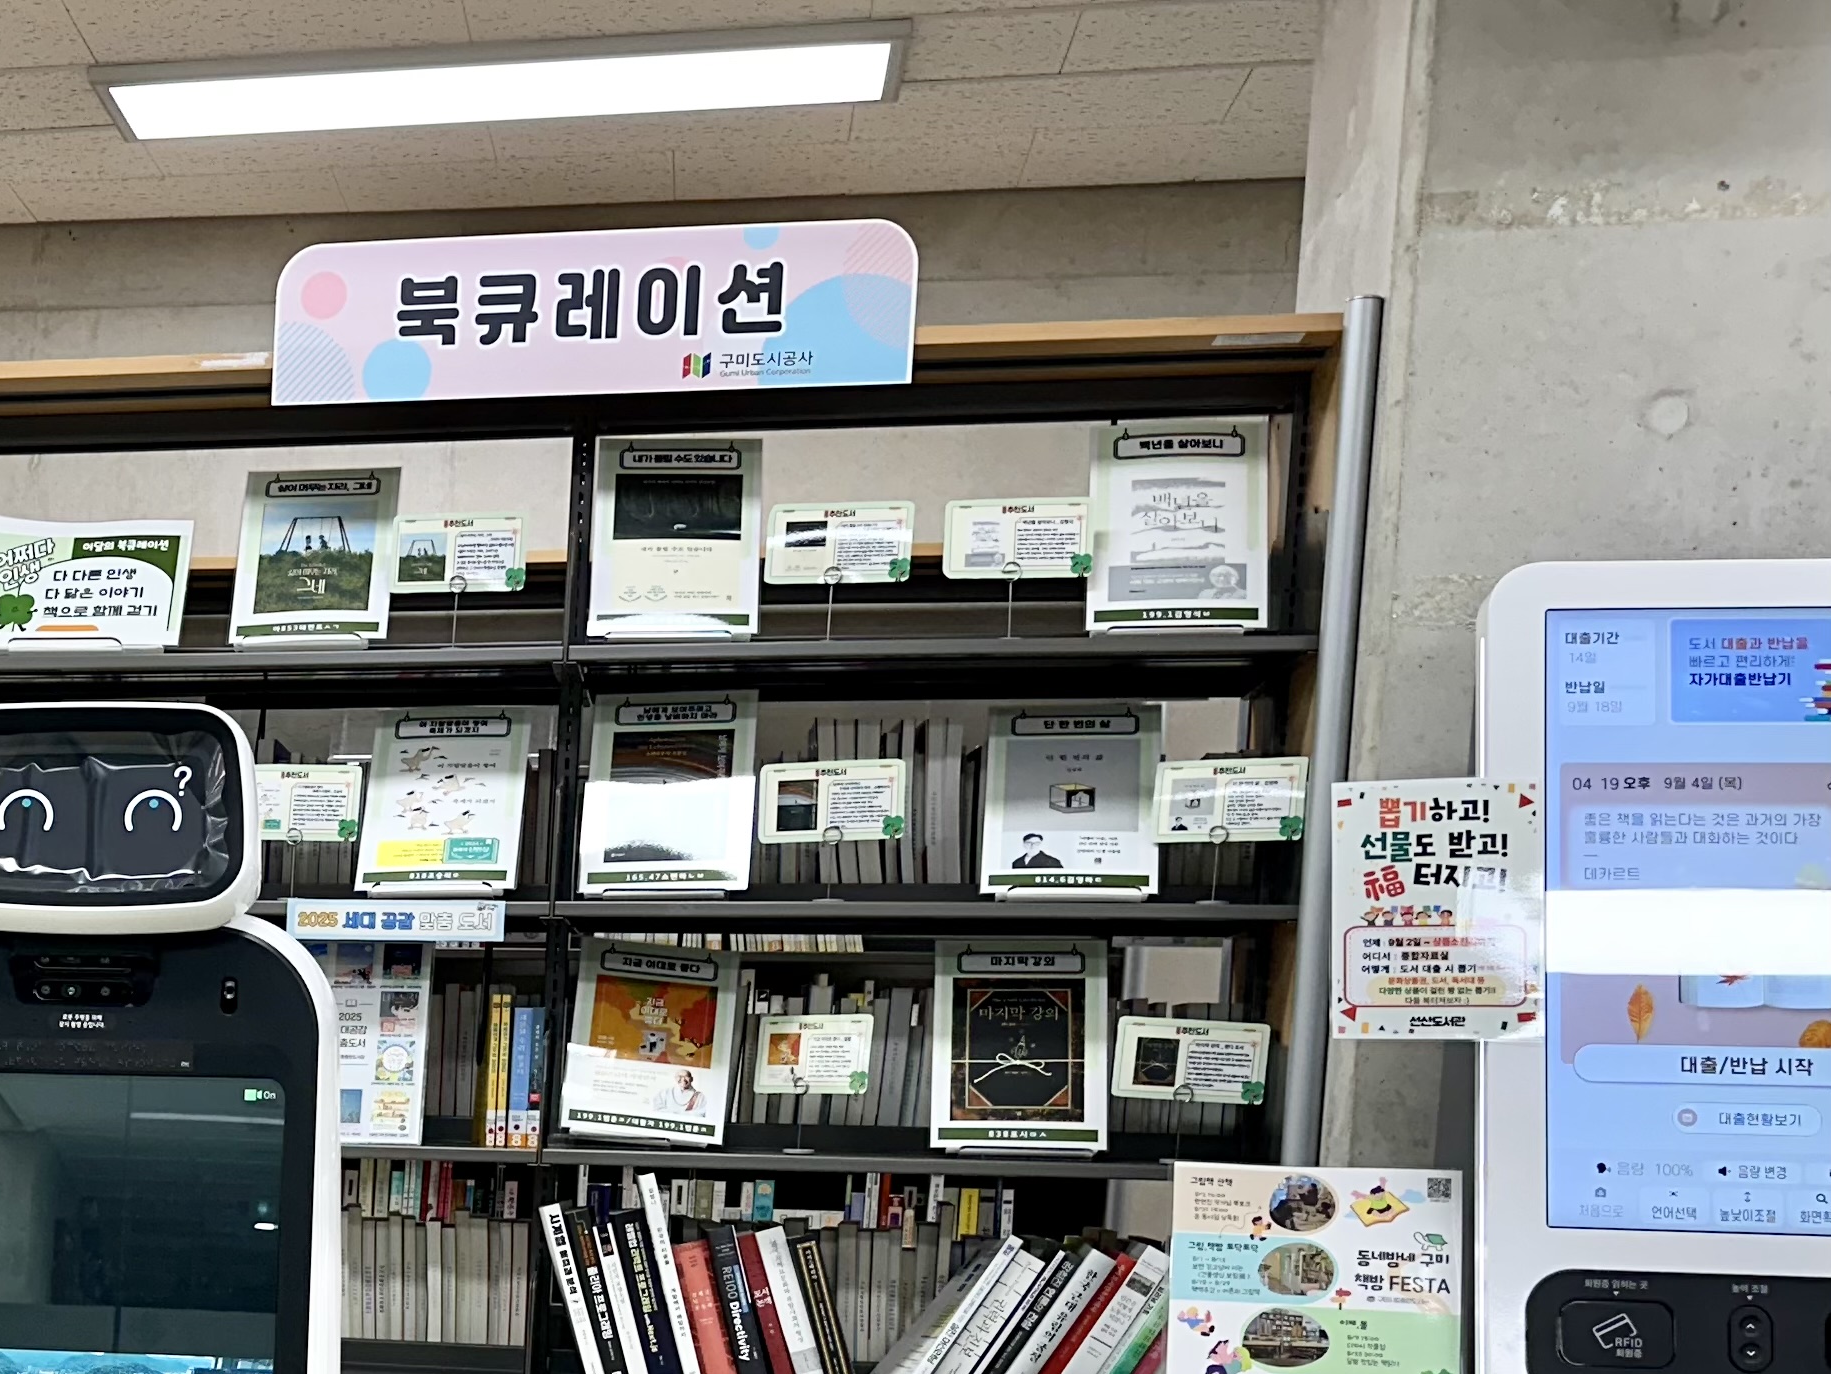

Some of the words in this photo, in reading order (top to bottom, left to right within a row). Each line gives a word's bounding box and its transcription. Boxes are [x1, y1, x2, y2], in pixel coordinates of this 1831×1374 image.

[397, 261, 784, 346] 북큐레이션
[720, 350, 813, 368] 구미도시공사
[1178, 439, 1224, 450] 살아보니
[82, 540, 115, 553] 이달의
[118, 539, 169, 551] 북큐레이션
[53, 569, 68, 582] 다
[72, 569, 102, 581] 다른
[107, 568, 136, 580] 인생
[297, 577, 326, 594] 그네
[45, 588, 60, 600] 다
[99, 587, 144, 599] 이야기
[43, 606, 88, 617] 책으로
[92, 605, 122, 617] 함께
[127, 605, 157, 617] 걷기
[1565, 631, 1619, 645] 대출기간
[1689, 638, 1716, 650] 도서
[1721, 637, 1763, 650] 대출과
[1767, 637, 1809, 650] 반납을
[1569, 652, 1597, 664] 14일
[1689, 673, 1792, 686] 자가대출반납기
[1565, 681, 1605, 694] 반납일
[1567, 701, 1588, 713] 9월
[1595, 701, 1622, 713] 18일
[1572, 778, 1592, 790] 04
[1601, 777, 1619, 790] 19
[1623, 777, 1651, 789] 오후
[1664, 777, 1686, 790] 9월
[1691, 777, 1713, 790] 4일
[1718, 777, 1742, 790] (목)
[1379, 797, 1490, 829] 뽑기하고!
[1584, 813, 1611, 826] 좋은
[1617, 812, 1644, 826] 책을
[1650, 813, 1706, 826] 읽는다는
[1712, 813, 1739, 826] 것은
[1745, 813, 1787, 826] 과거의
[1793, 813, 1821, 827] 가장
[1584, 831, 1626, 845] 훌륭한
[1631, 831, 1688, 845] 사람들과
[1693, 831, 1750, 845] 대화하는
[1755, 831, 1798, 845] 것이다
[1360, 831, 1436, 863] 선물도
[1448, 829, 1508, 858] 받고!
[1584, 867, 1640, 881] 데카르트
[1363, 864, 1405, 901] 福
[298, 911, 338, 927] 2025
[381, 911, 415, 930] 공감
[419, 911, 453, 930] 맞춤
[457, 912, 492, 931] 도서
[990, 956, 1029, 967] 마지막
[1032, 956, 1056, 967] 강의
[1401, 951, 1449, 961] 종합자료실
[979, 1006, 1025, 1021] 마지막
[1031, 1005, 1059, 1021] 강의
[1410, 1016, 1465, 1027] 선산도서관
[1680, 1056, 1768, 1076] 대출/반납
[1775, 1057, 1814, 1077] 시작
[1718, 1112, 1802, 1127] 대출현황보기
[1617, 1162, 1644, 1176] 음량
[1655, 1163, 1694, 1177] 100%
[1738, 1165, 1760, 1179] 음량
[1764, 1165, 1787, 1180] 변경
[1579, 1204, 1624, 1218] 처음으로
[1652, 1206, 1697, 1221] 언어선택
[1720, 1208, 1776, 1223] 높낮이조절
[1356, 1250, 1416, 1268] 동네방네
[1420, 1253, 1449, 1268] 구미
[722, 1266, 737, 1300] RE100
[1354, 1273, 1385, 1291] 책방
[1389, 1276, 1451, 1294] FESTA
[729, 1301, 751, 1362] Directivity
[1615, 1337, 1643, 1348] RFID
